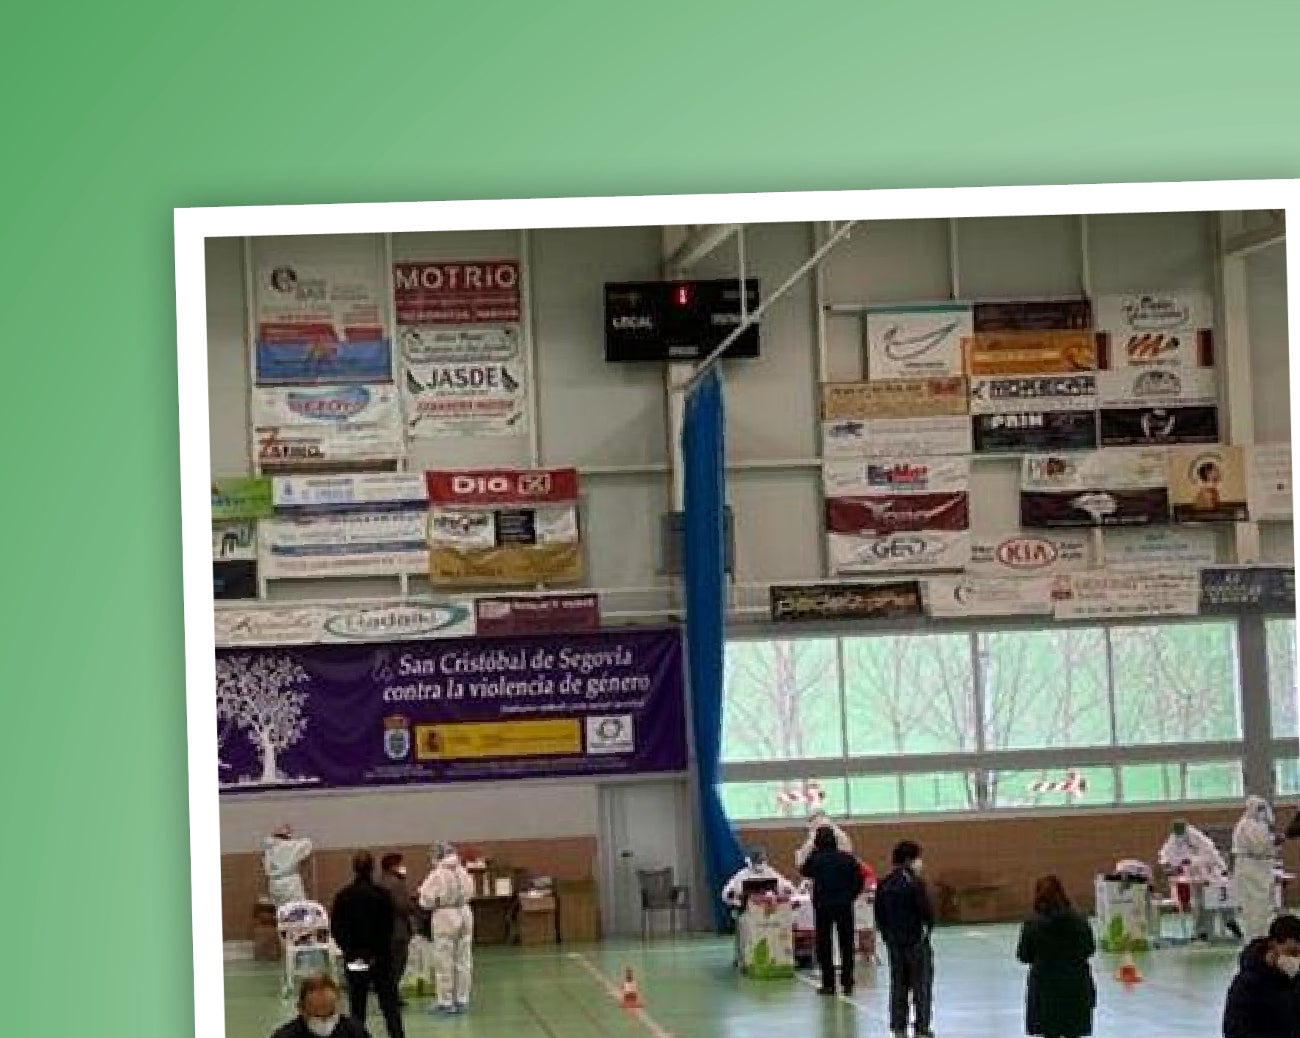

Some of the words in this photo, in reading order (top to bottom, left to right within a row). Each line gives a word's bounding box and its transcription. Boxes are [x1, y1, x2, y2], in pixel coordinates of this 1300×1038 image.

[396, 264, 516, 289] MOTRIO
[425, 366, 499, 390] JASDE
[399, 653, 435, 676] San
[440, 648, 526, 674] Cristóbal
[530, 649, 553, 670] de
[560, 645, 632, 674] Segovia
[383, 682, 440, 702] contra
[447, 679, 464, 699] la
[469, 676, 553, 699] violencia
[560, 672, 581, 694] de
[586, 672, 650, 699] género
